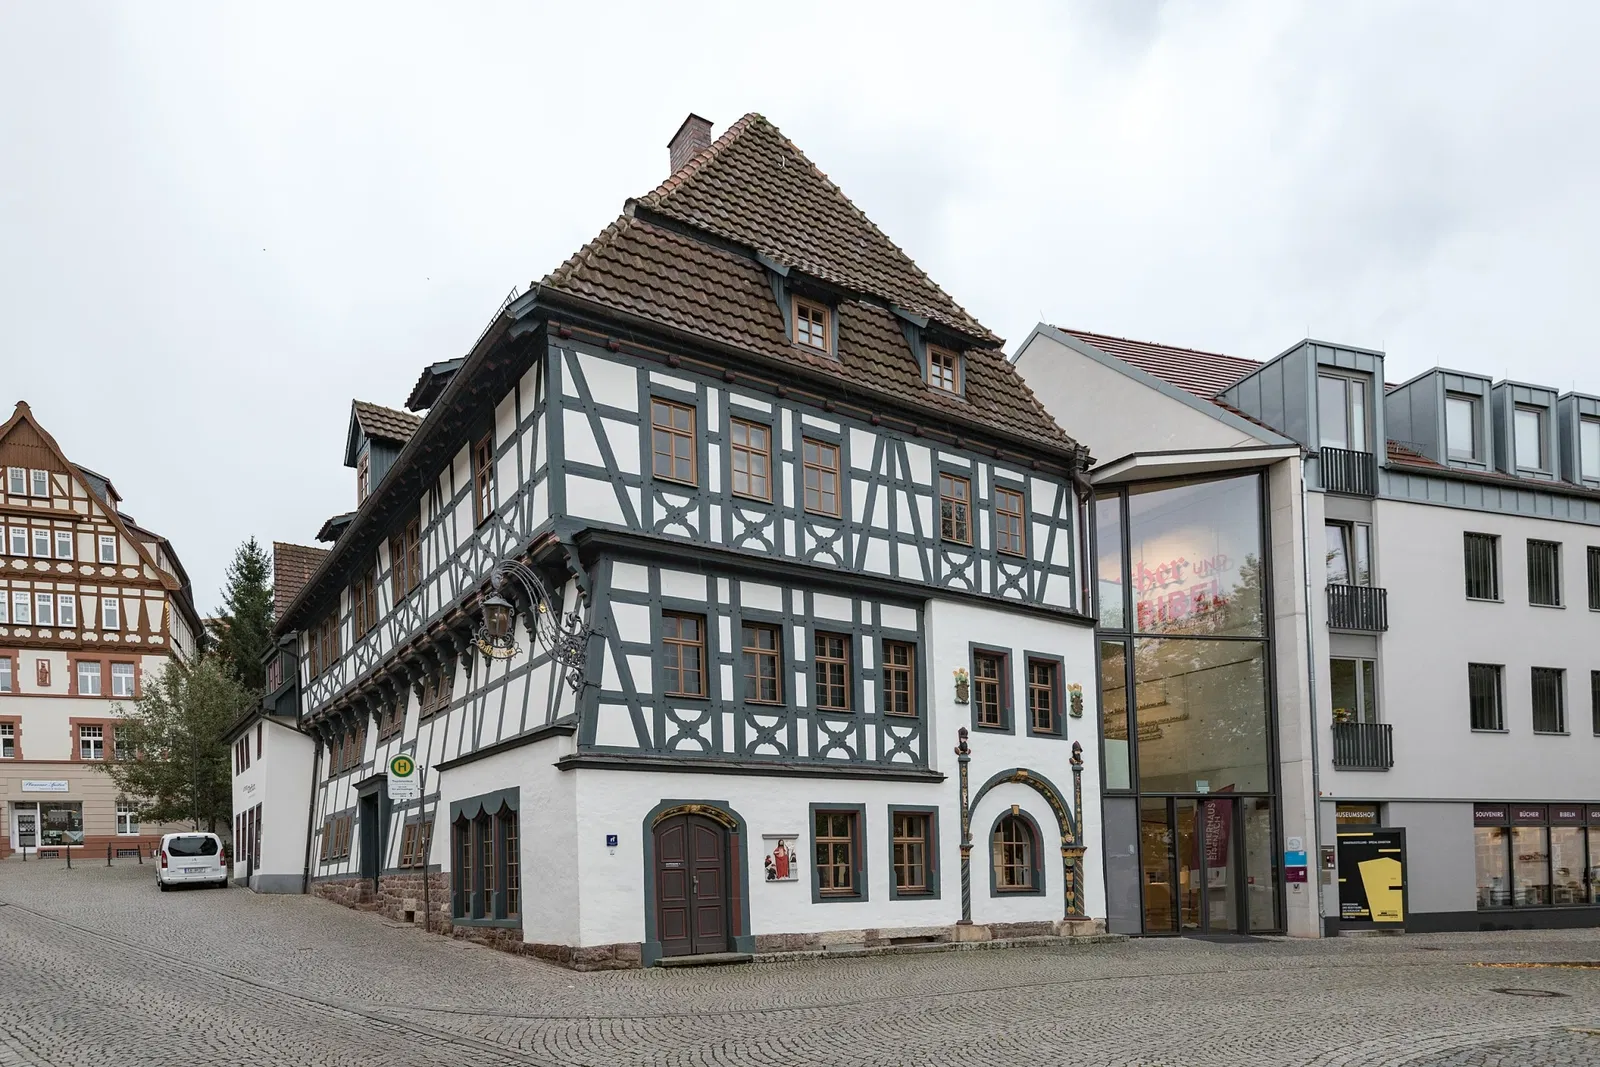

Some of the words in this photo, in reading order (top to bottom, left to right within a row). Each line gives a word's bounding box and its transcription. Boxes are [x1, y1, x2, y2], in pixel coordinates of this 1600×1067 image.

[1136, 580, 1229, 629] BIBEL
[398, 762, 407, 772] H
[1519, 810, 1540, 818] BÜCHER
[1210, 815, 1221, 861] EISENACH
